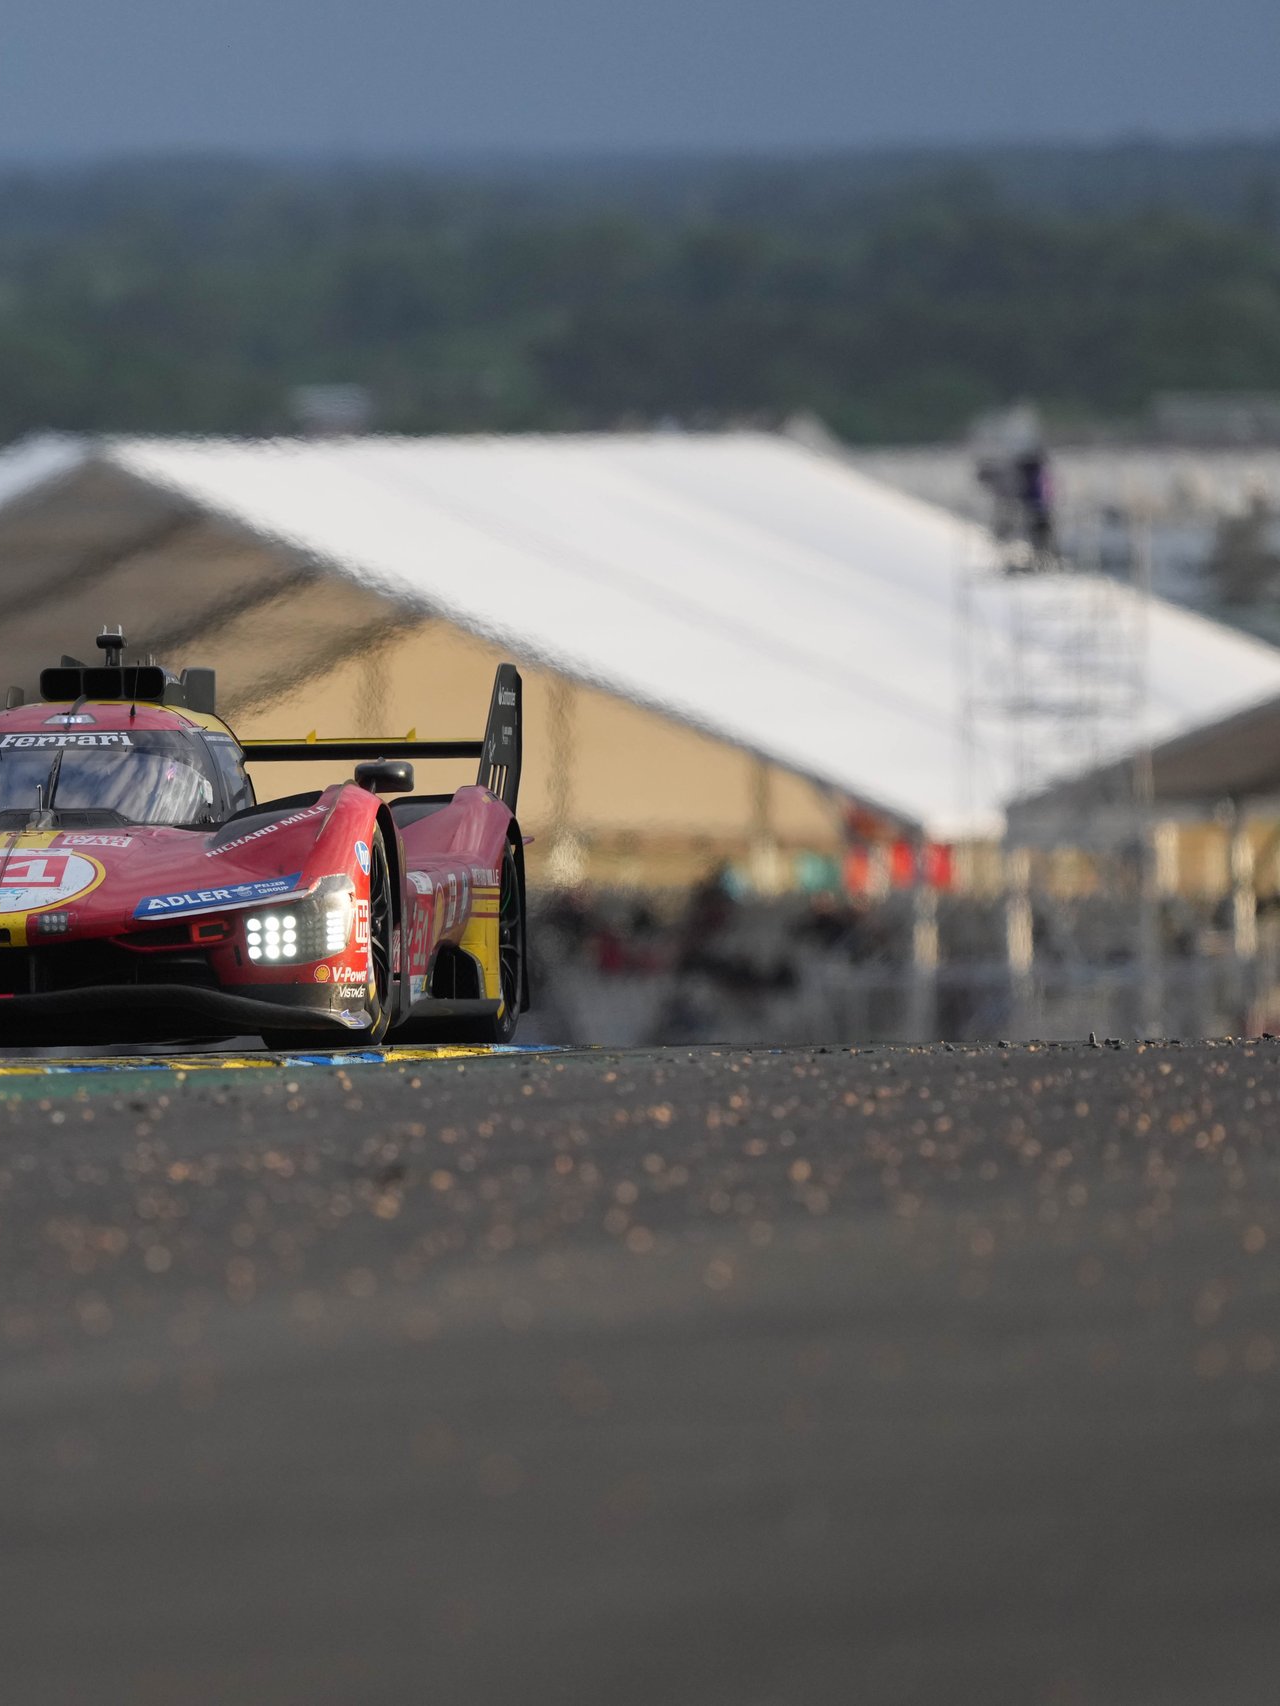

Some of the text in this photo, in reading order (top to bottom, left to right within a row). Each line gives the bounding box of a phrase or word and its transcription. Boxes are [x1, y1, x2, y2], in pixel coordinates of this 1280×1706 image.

[205, 804, 330, 858] RICHARD MILLE
[357, 843, 370, 874] hp
[254, 881, 286, 889] PELZER
[257, 885, 289, 894] GROUP
[147, 889, 233, 910] ADLER
[332, 966, 367, 982] V-Power
